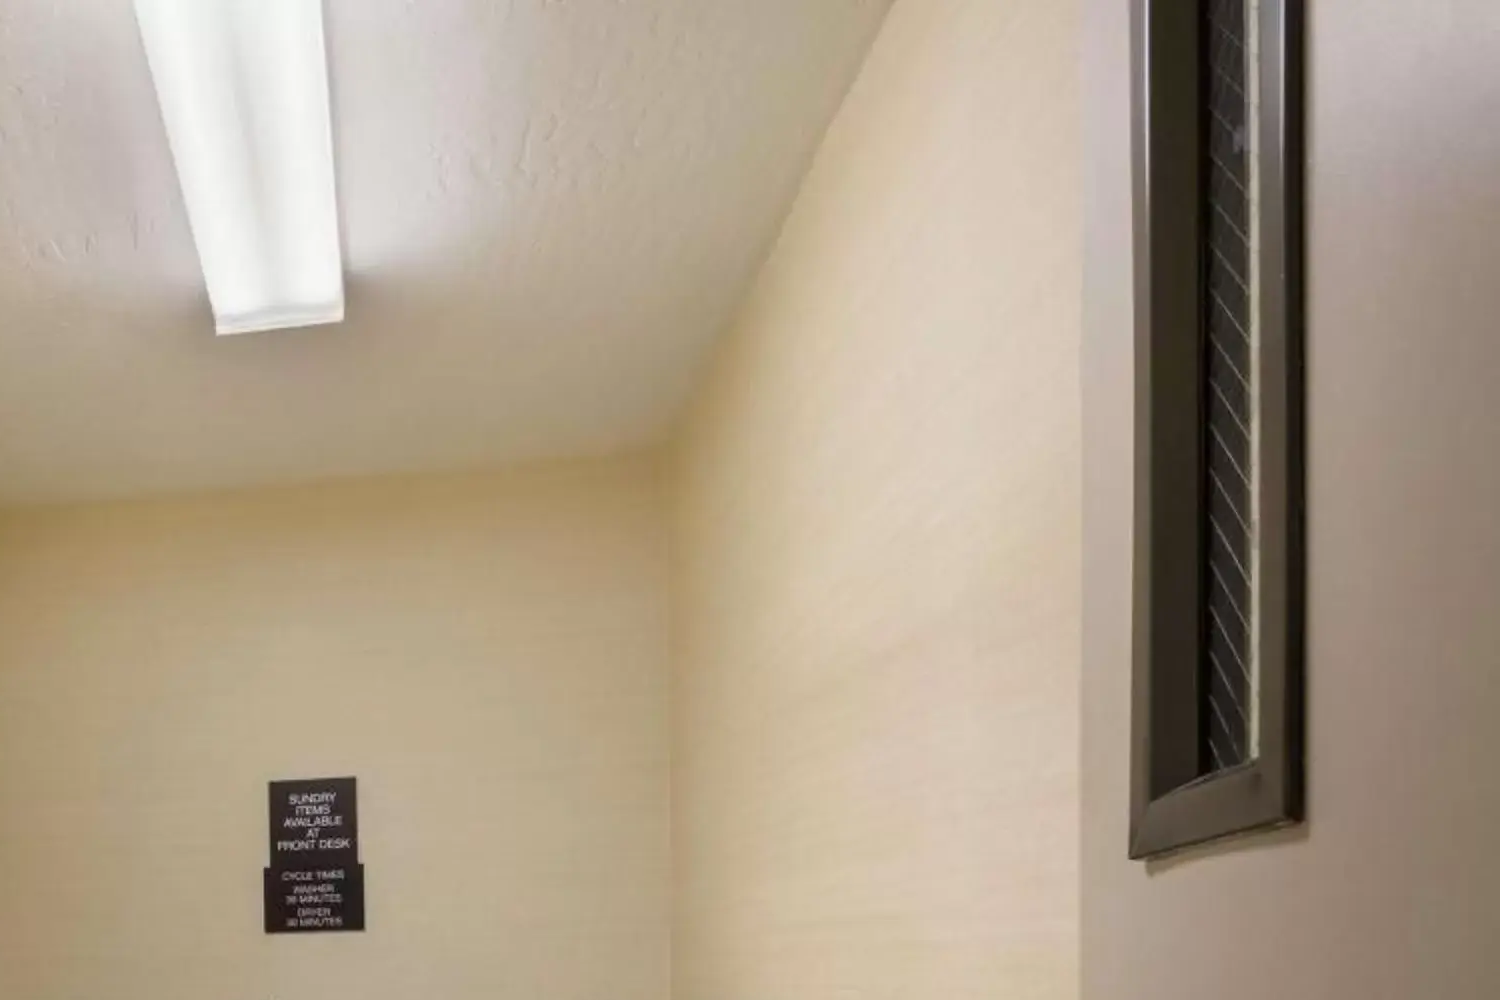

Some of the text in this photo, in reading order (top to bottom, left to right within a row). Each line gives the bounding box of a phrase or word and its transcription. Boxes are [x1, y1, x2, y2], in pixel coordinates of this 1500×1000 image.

[288, 792, 337, 805] SUNDRY
[295, 804, 332, 816] ITEMS
[283, 815, 343, 828] AVAILABLE
[306, 827, 321, 838] AT
[277, 837, 350, 851] FRONT DESK
[281, 871, 314, 881] CYCLE
[299, 893, 341, 904] MINUTES
[299, 916, 343, 927] MINUTES
